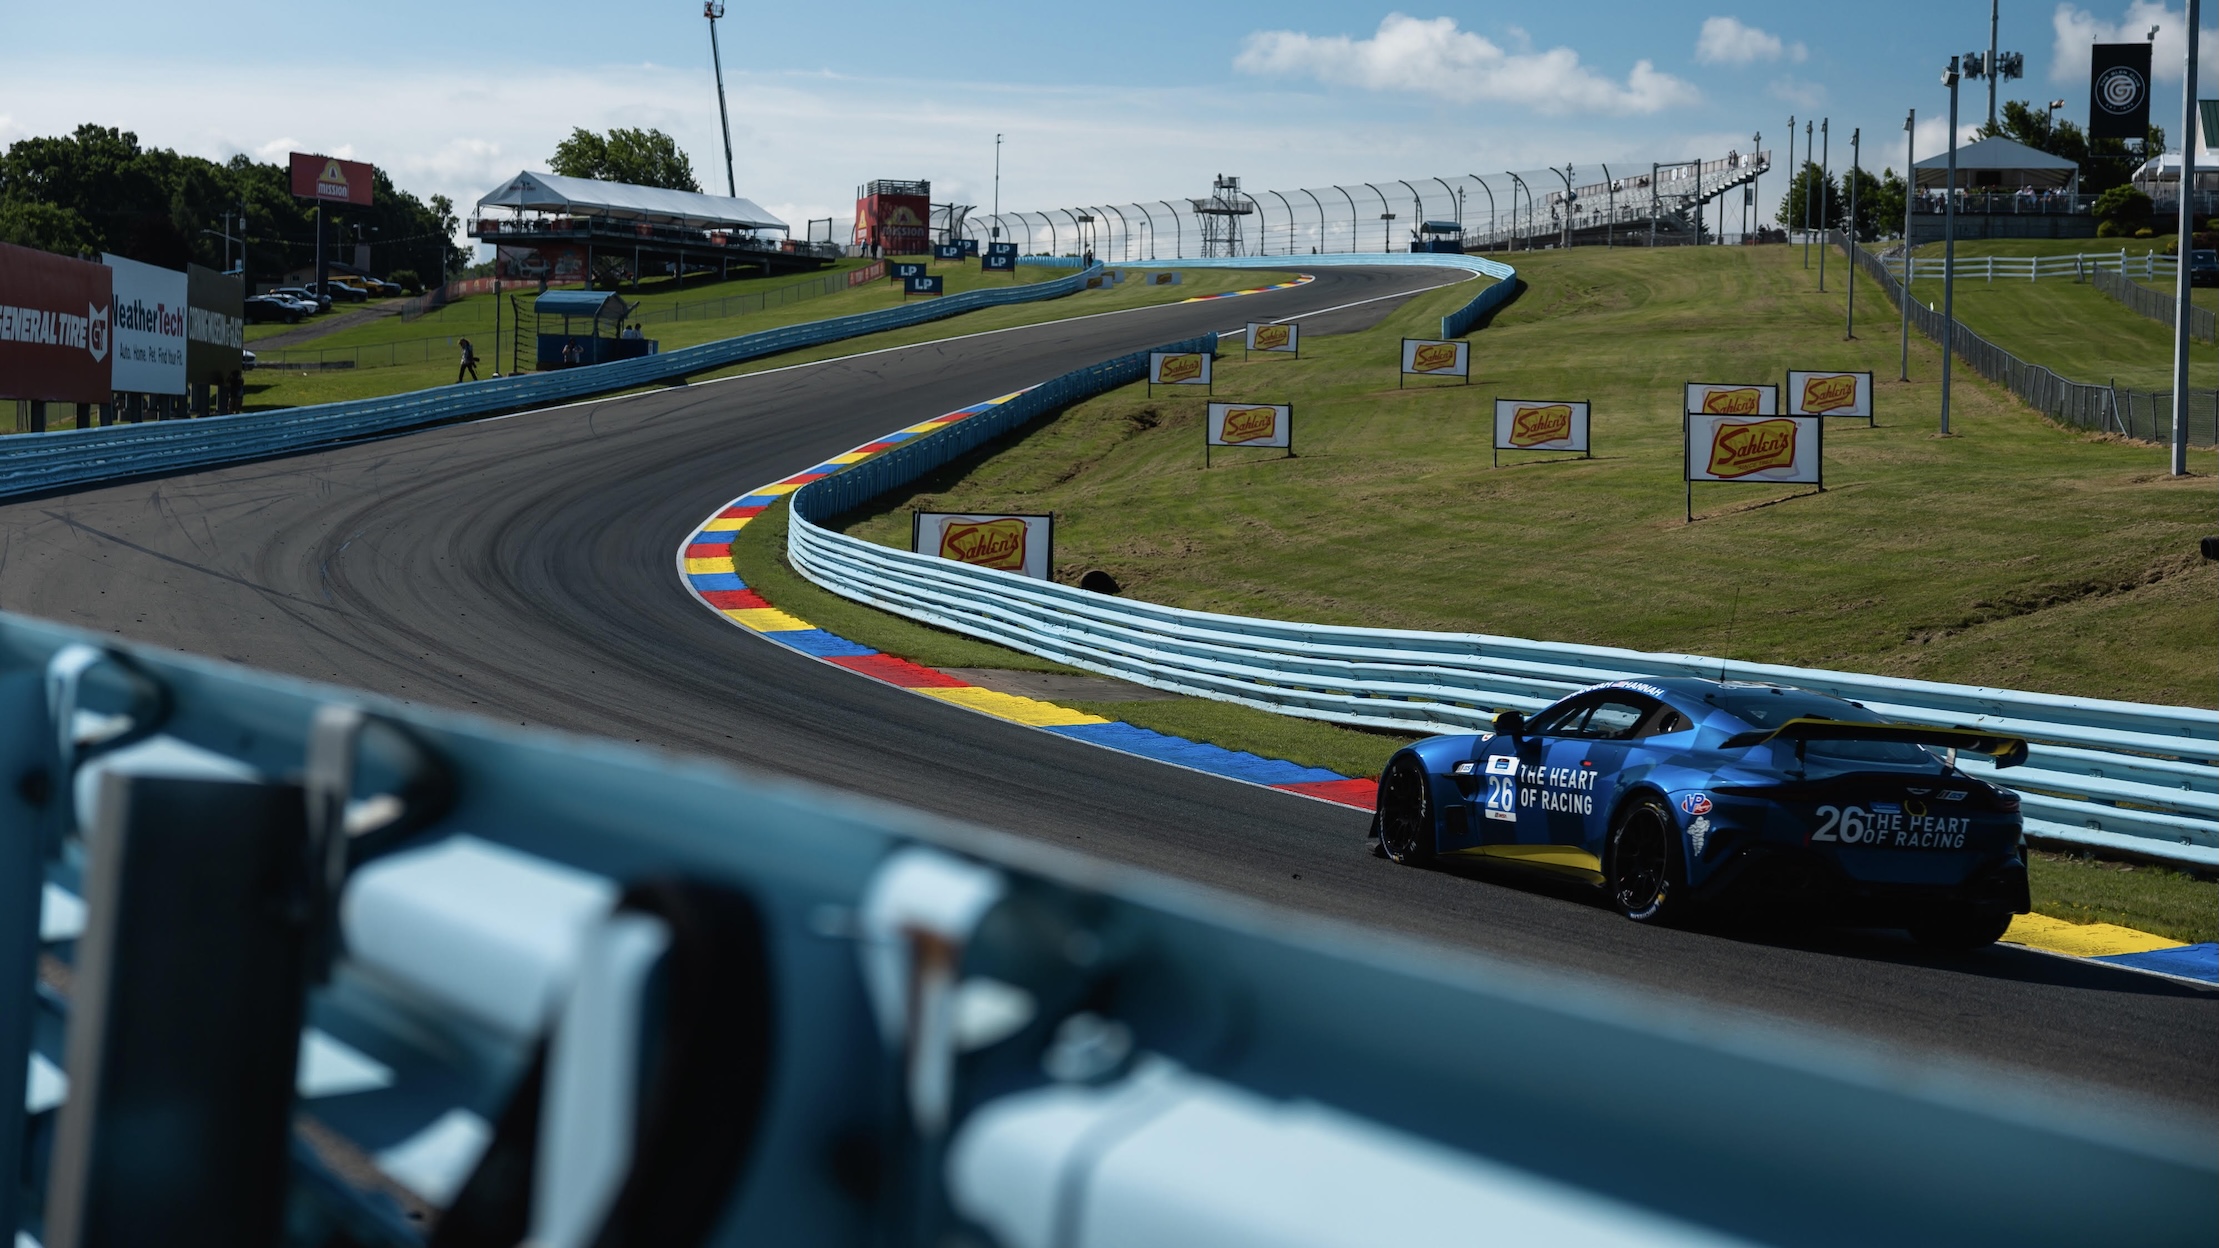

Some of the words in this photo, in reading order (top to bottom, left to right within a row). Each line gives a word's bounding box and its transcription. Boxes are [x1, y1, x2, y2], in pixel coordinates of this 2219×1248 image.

[943, 247, 957, 256] LP
[996, 244, 1010, 253] LP
[901, 266, 917, 276] LP
[991, 257, 1006, 267] LP
[915, 278, 933, 290] LP
[0, 304, 57, 345] ENERAL
[59, 312, 88, 349] TIRE
[1807, 381, 1852, 405] Sahlen's
[1516, 411, 1567, 437] Sahlen's
[1716, 428, 1789, 465] Sahlen's
[947, 527, 1019, 561] Sahlen's
[1623, 681, 1665, 697] HANNAH
[1520, 764, 1547, 785] THE
[1550, 767, 1598, 791] HEART
[1487, 775, 1513, 812] 26
[1520, 788, 1537, 808] OF
[1542, 790, 1593, 816] RACING
[1686, 794, 1705, 813] VP
[1811, 805, 1865, 844] 26
[1864, 813, 1903, 831] THE
[1910, 816, 1970, 834] HEART
[1863, 830, 1888, 844] OF
[1895, 831, 1966, 849] RACING
